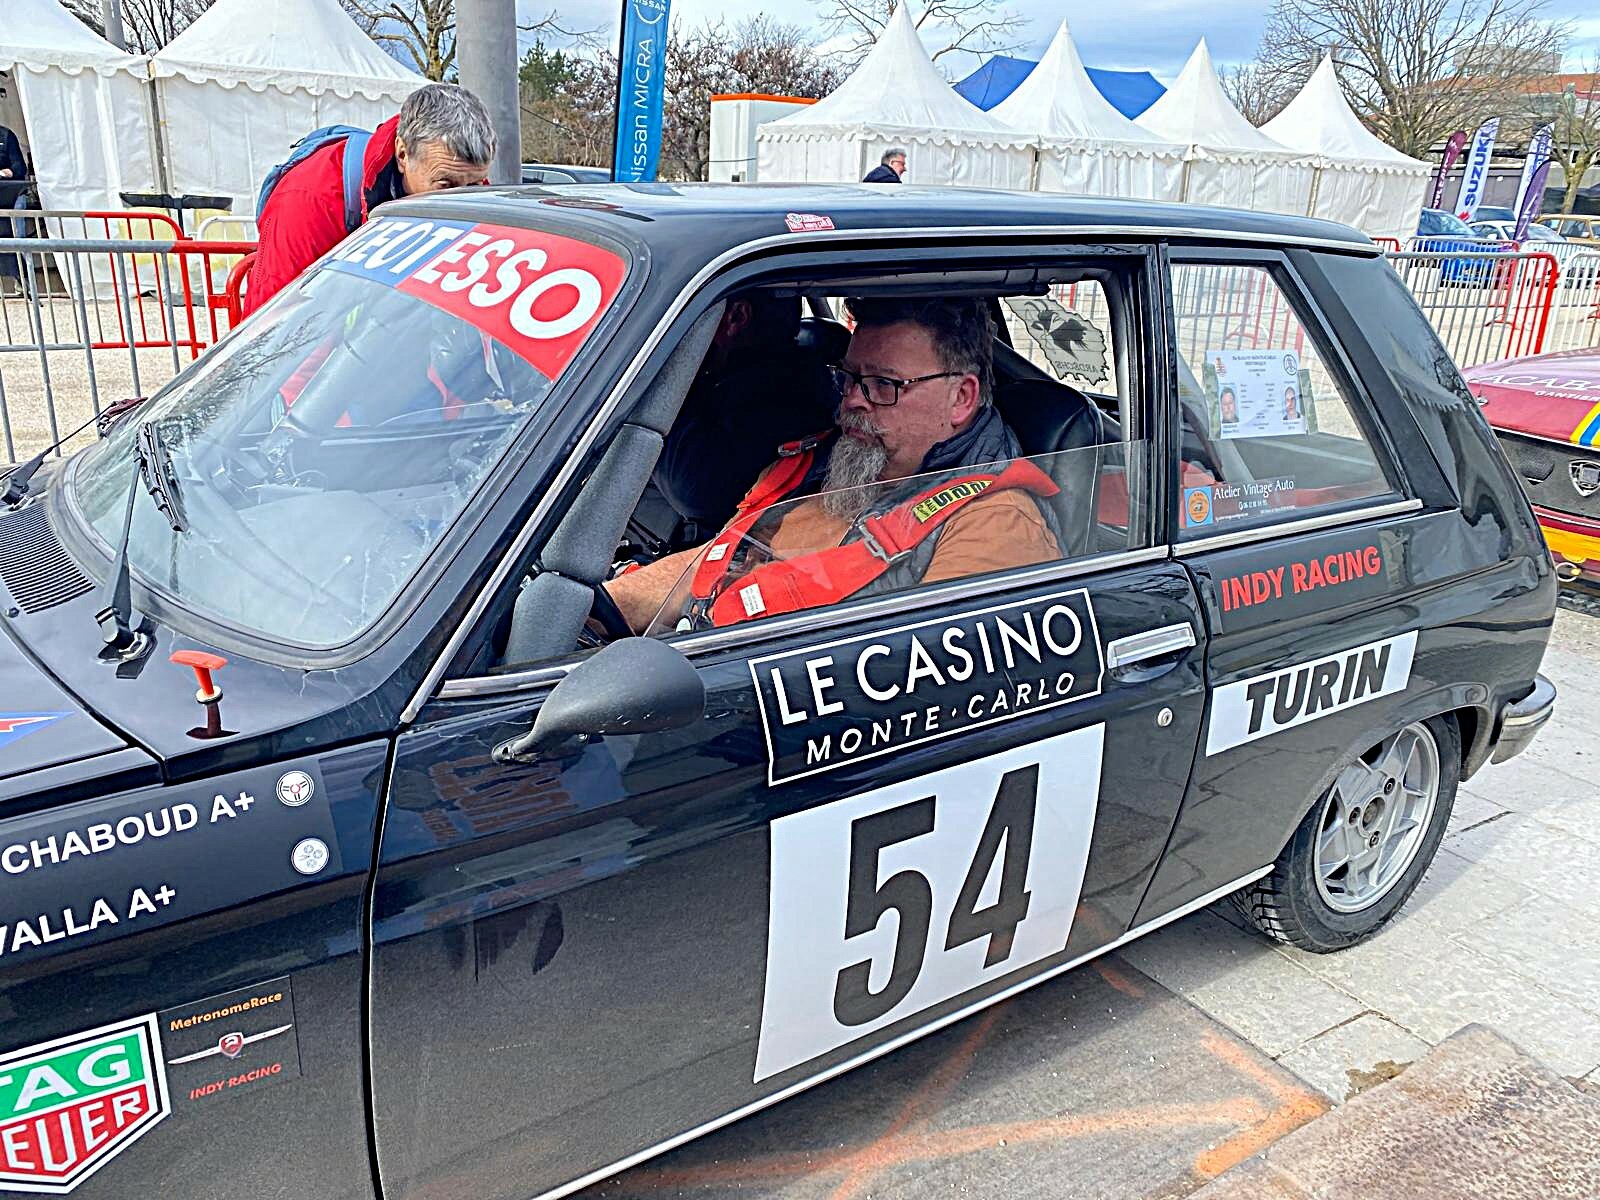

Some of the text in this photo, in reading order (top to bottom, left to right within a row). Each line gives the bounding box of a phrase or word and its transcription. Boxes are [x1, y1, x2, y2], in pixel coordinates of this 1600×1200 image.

[634, 39, 653, 109] MICRA
[1465, 131, 1492, 207] SUZUKI
[413, 232, 602, 339] ESSO
[1213, 480, 1294, 500] Atelier Vintage Auto
[1222, 545, 1381, 611] INDY RACING
[771, 604, 1082, 725] LE CASINO
[1245, 643, 1393, 735] TURIN
[1, 791, 256, 875] CHABOUD A+
[127, 884, 177, 919] A+
[833, 762, 1040, 1027] 54
[169, 992, 283, 1032] MetronomeRace
[189, 1063, 283, 1100] INDY RACING
